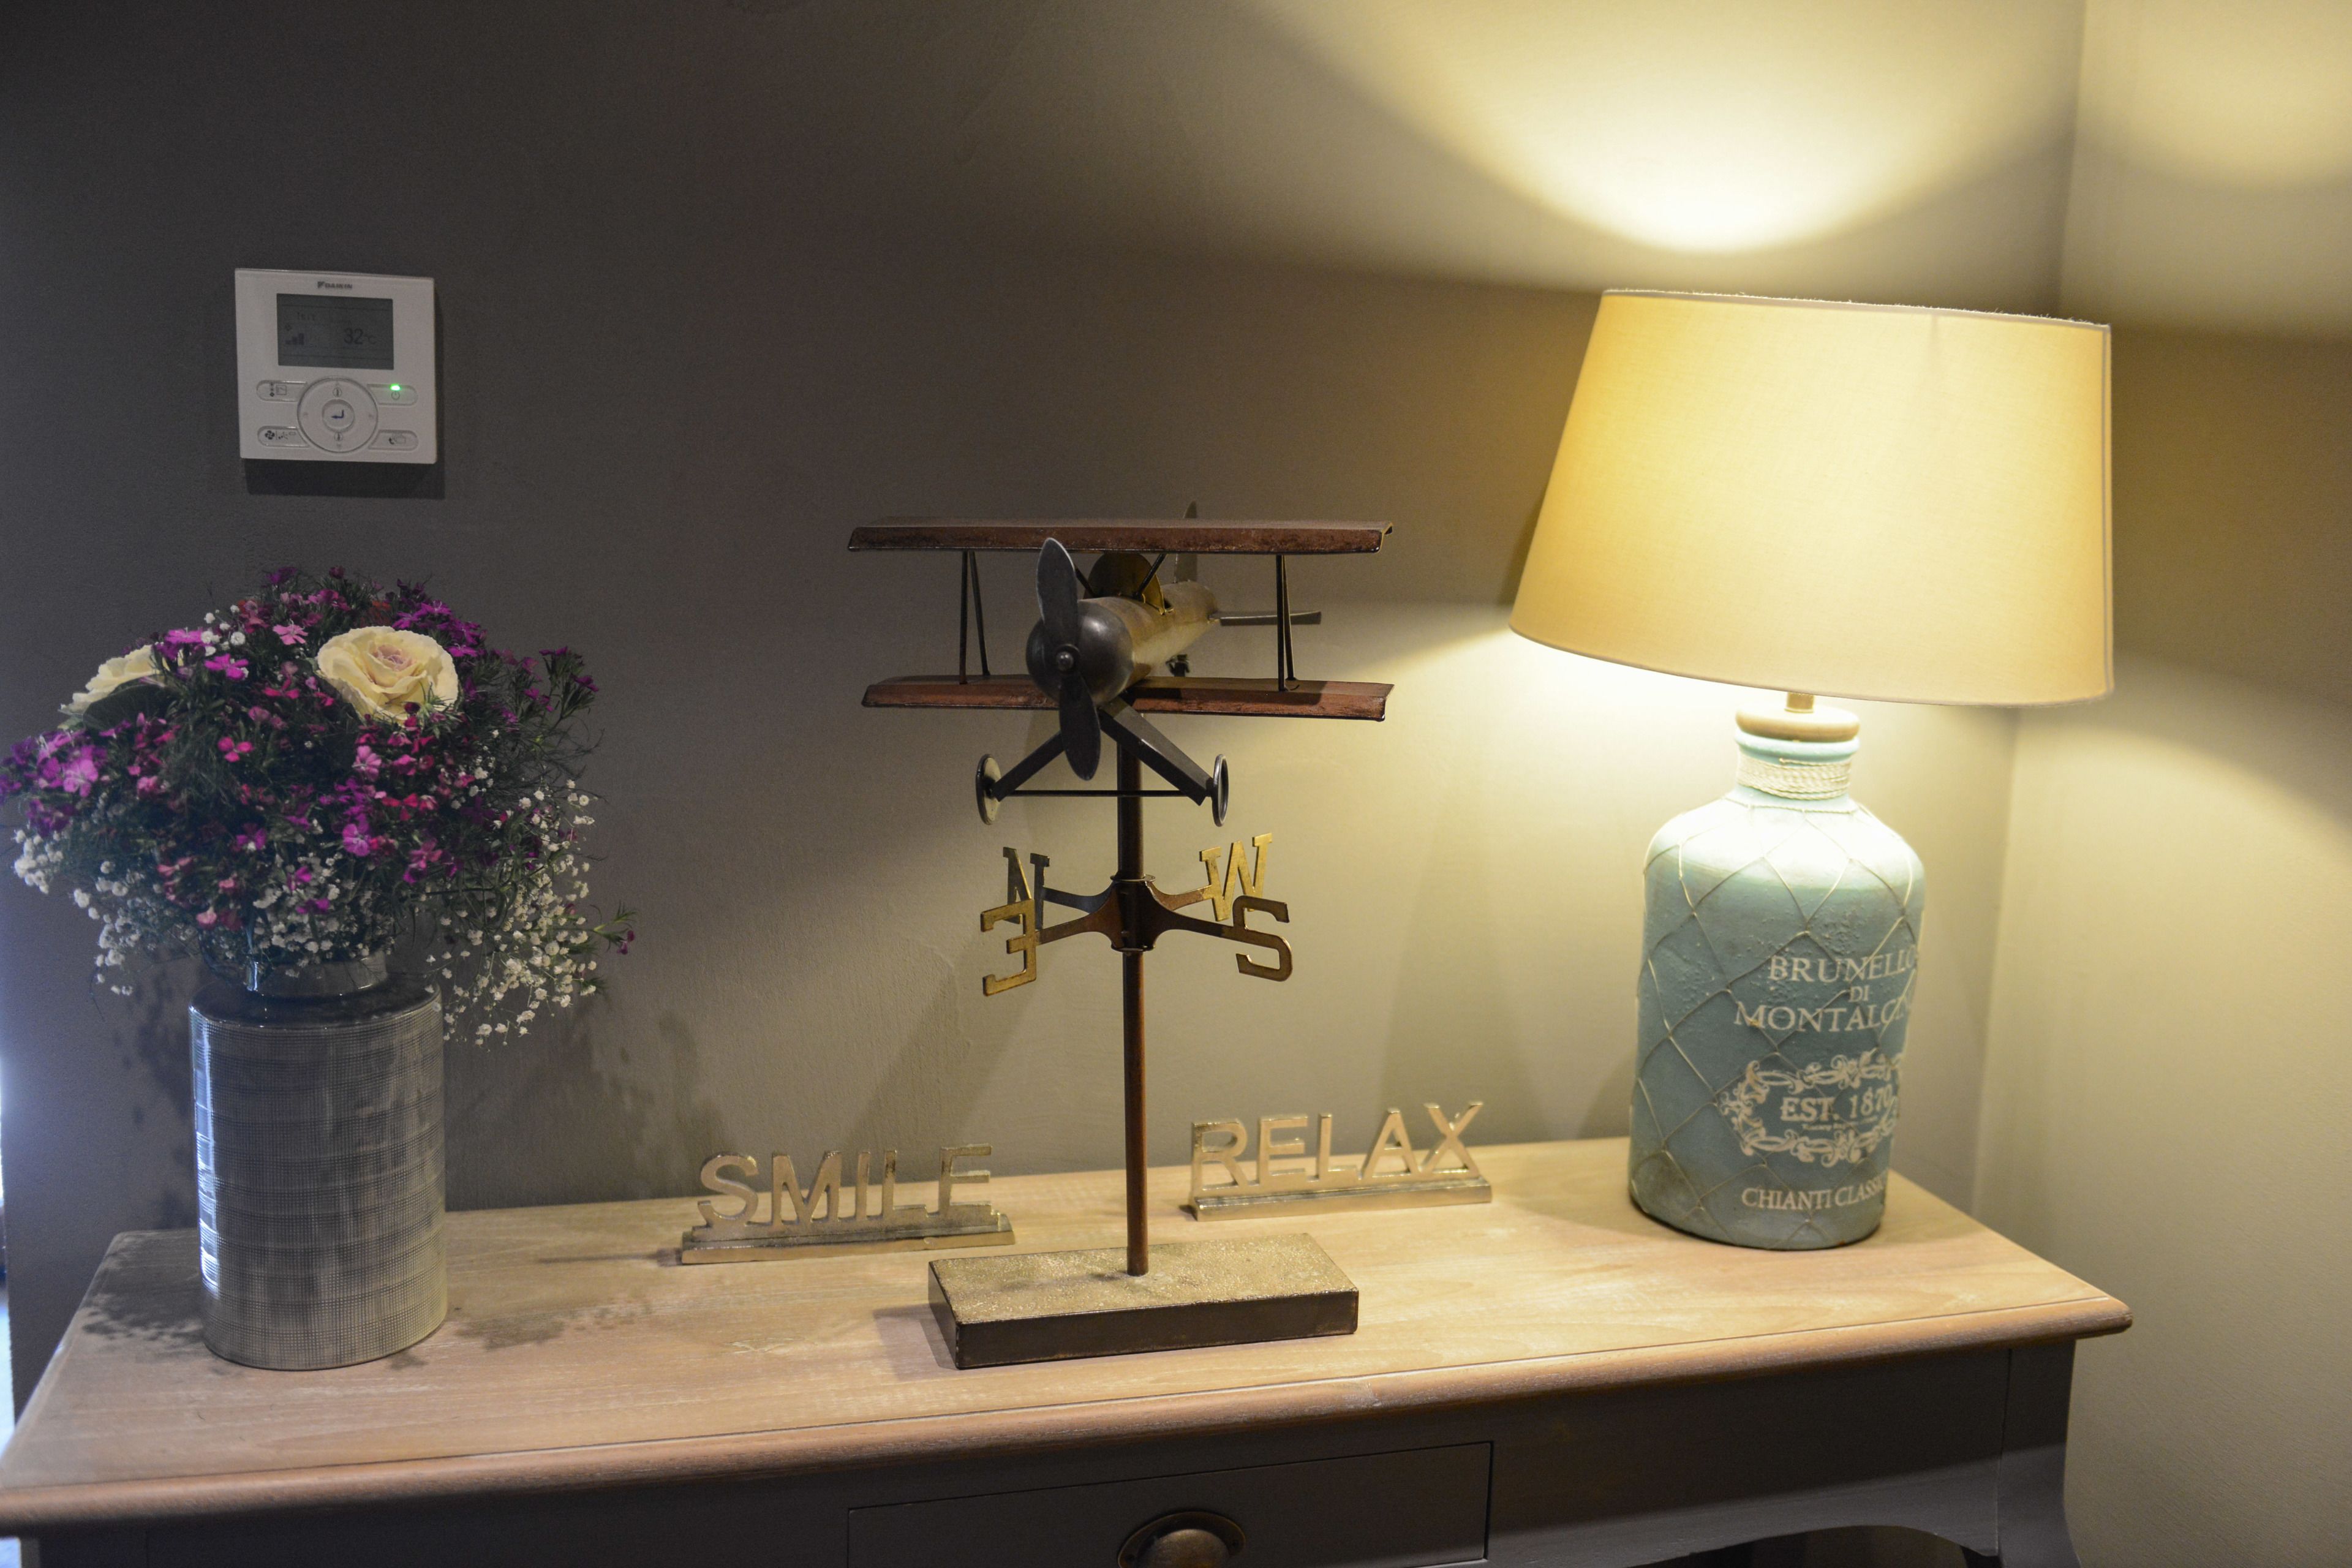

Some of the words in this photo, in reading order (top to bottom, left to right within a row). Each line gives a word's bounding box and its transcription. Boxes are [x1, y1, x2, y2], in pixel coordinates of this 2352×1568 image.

[1003, 846, 1050, 930] N
[1199, 832, 1272, 921] W
[1232, 894, 1292, 981] S
[1848, 984, 1870, 1003] DI
[696, 1144, 992, 1227] SMILE
[1191, 1101, 1483, 1194] RELAX
[1741, 1186, 1833, 1211] CHIANTI
